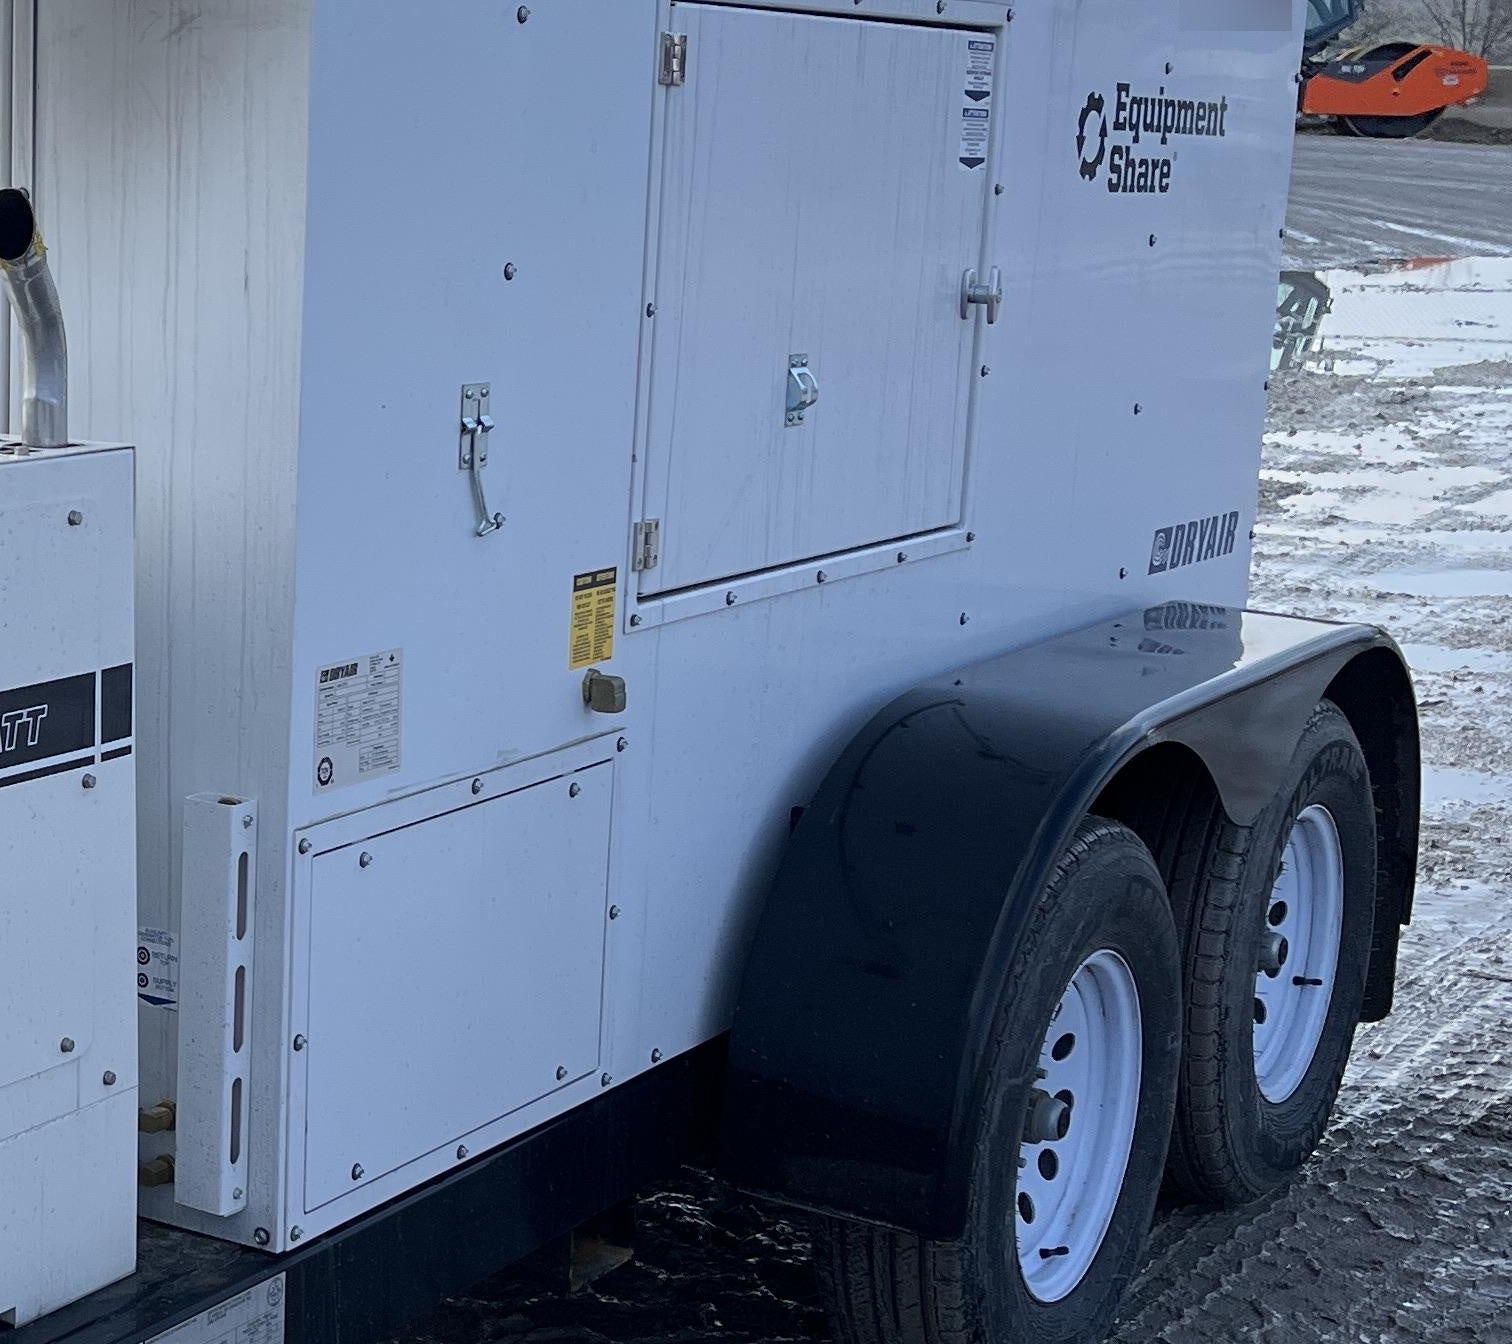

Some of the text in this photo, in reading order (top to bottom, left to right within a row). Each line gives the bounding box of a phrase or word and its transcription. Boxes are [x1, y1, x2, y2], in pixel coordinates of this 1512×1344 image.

[1112, 82, 1228, 145] Equipment
[1107, 145, 1172, 193] Share
[1168, 511, 1239, 570] DRYAIR
